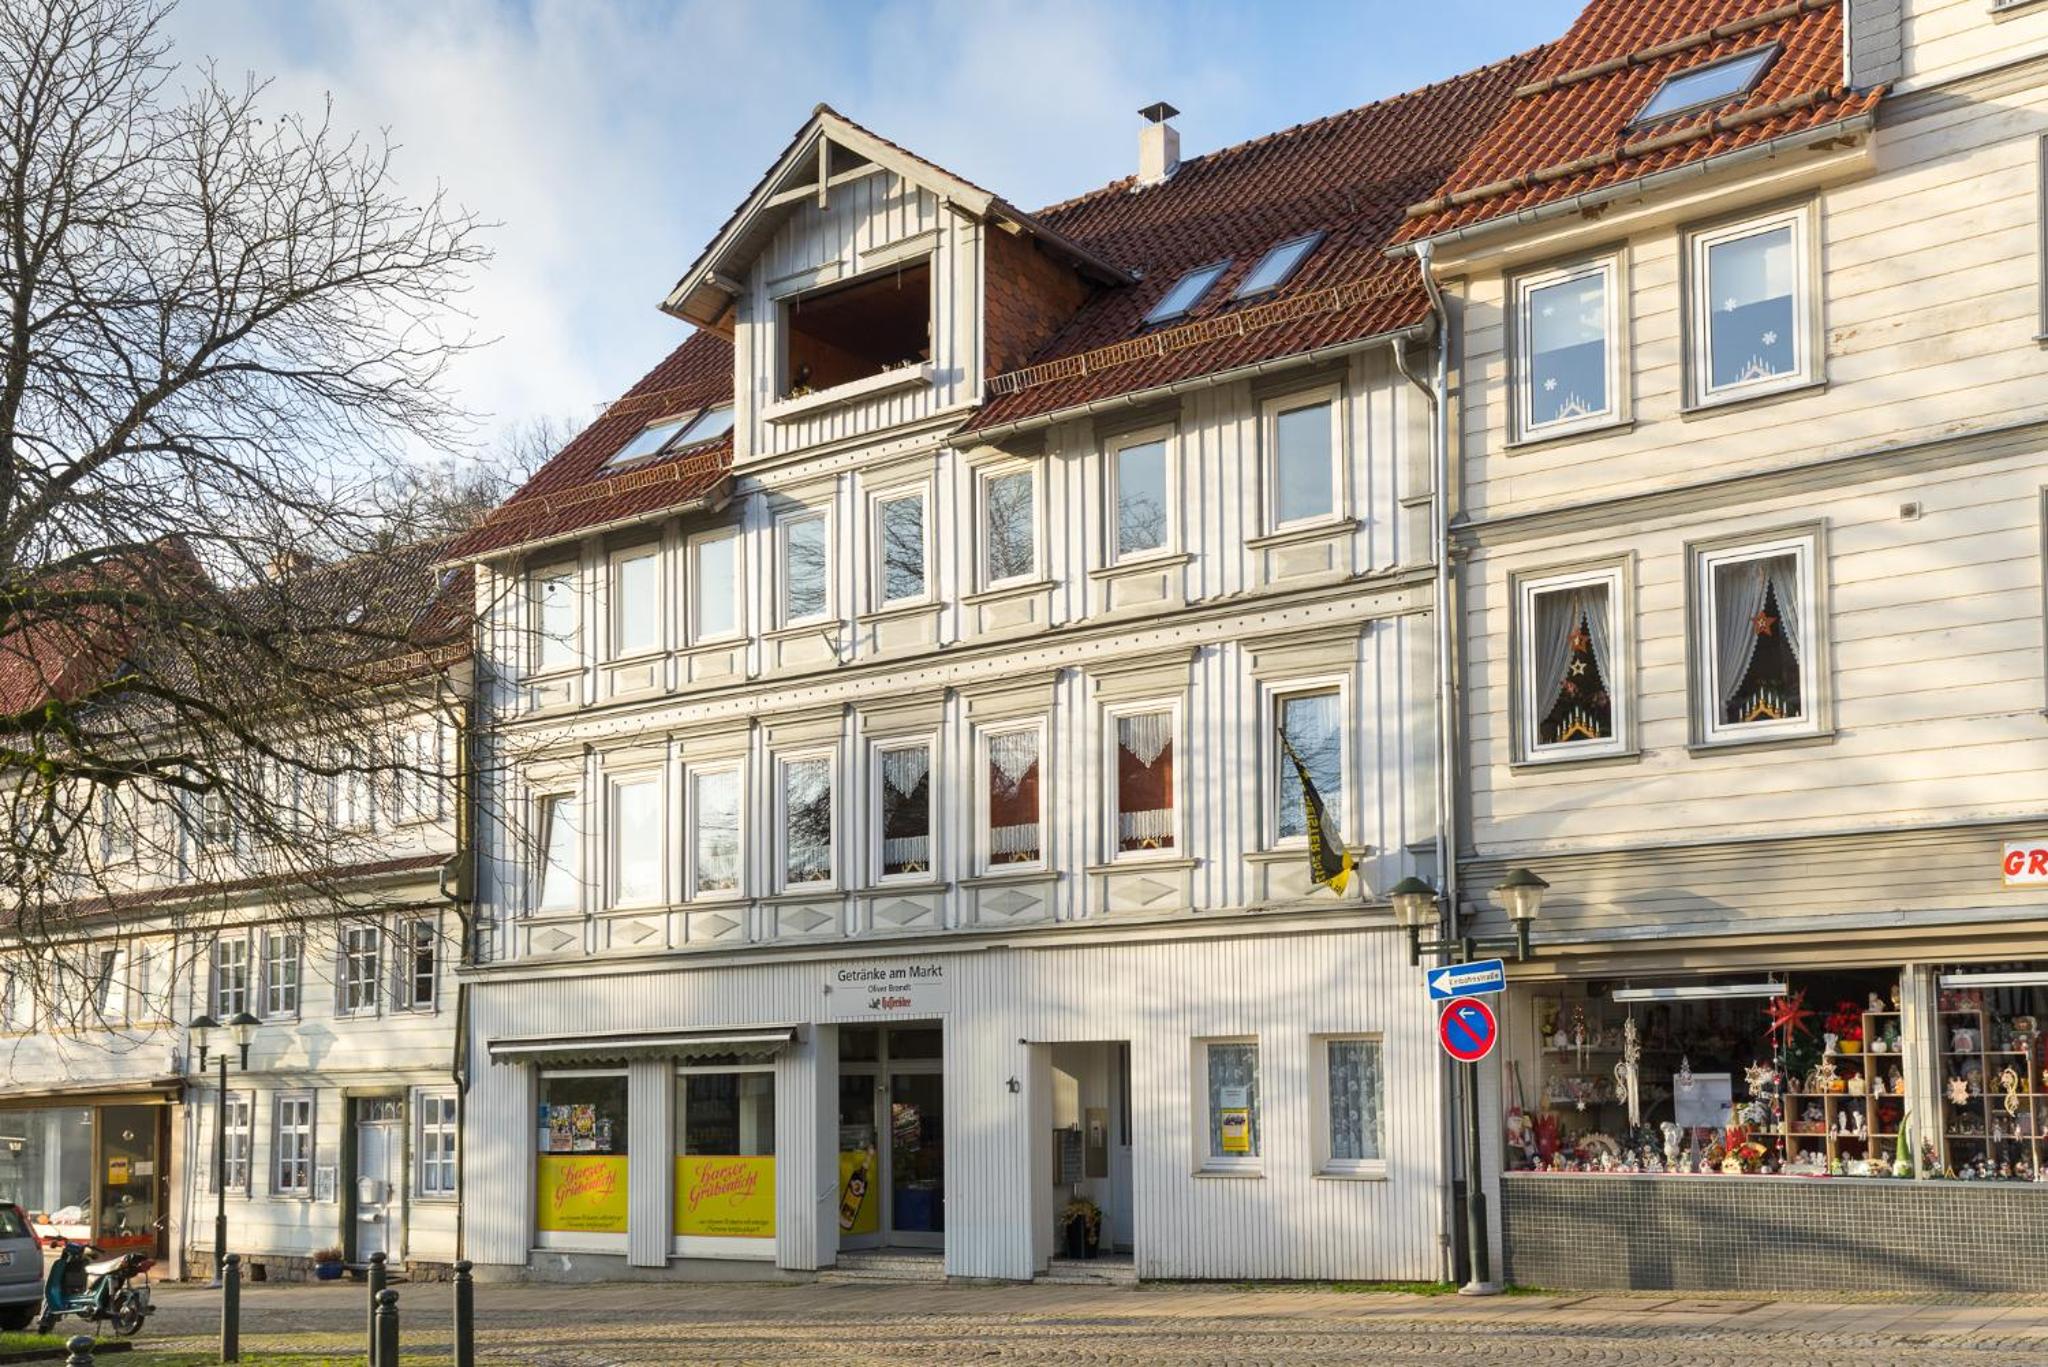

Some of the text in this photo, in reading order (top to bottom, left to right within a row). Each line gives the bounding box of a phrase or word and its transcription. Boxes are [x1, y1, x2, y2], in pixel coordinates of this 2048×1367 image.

[2004, 848, 2048, 876] GR
[837, 964, 943, 982] Getränke am Markt
[867, 983, 912, 994] Oliver Brandt
